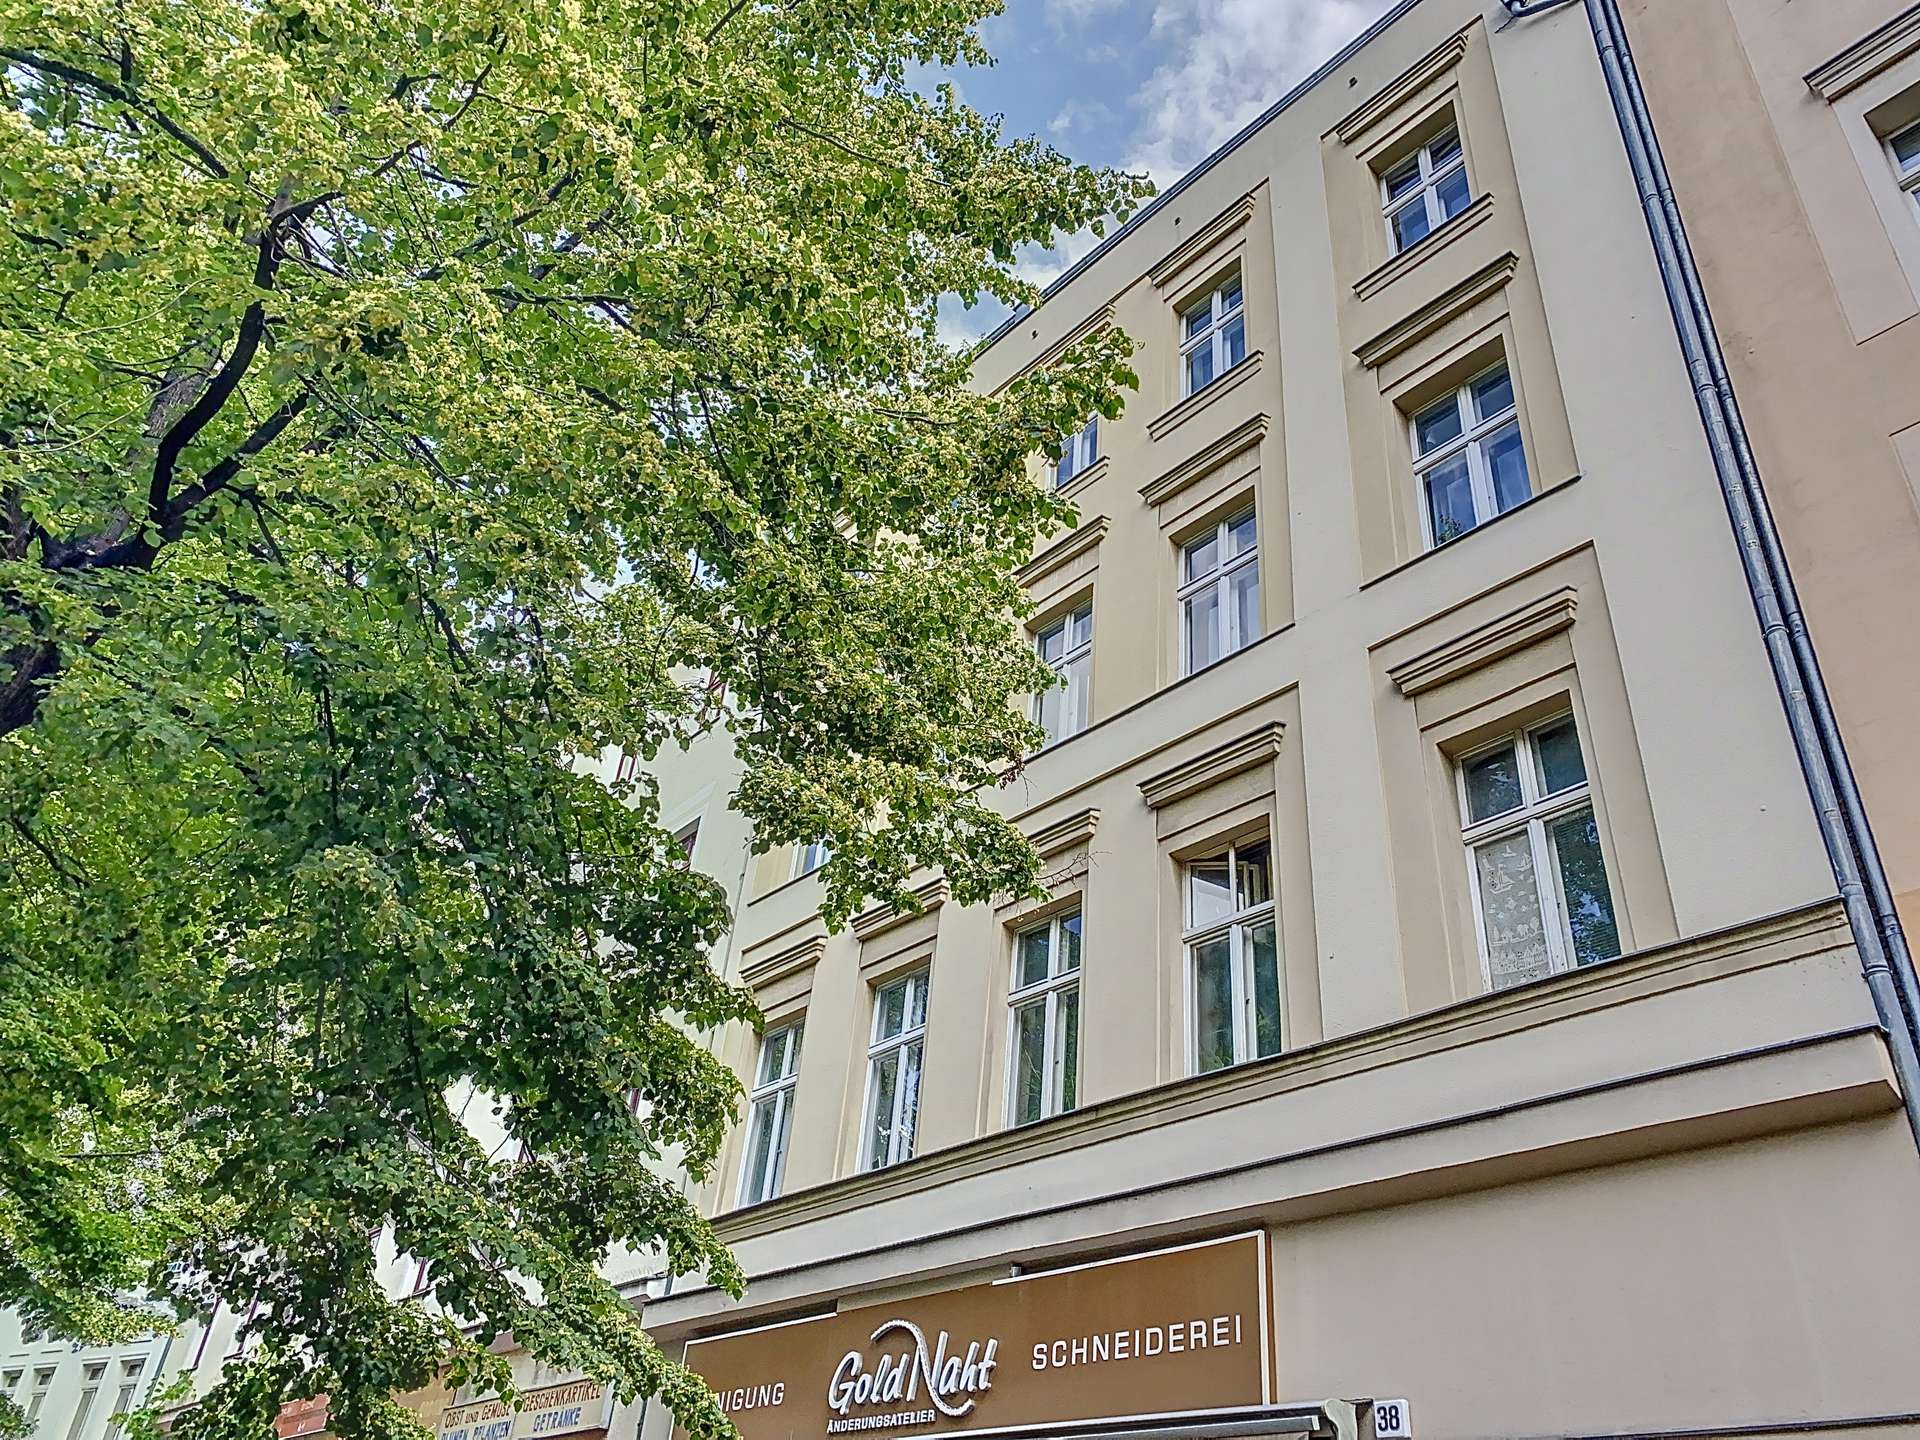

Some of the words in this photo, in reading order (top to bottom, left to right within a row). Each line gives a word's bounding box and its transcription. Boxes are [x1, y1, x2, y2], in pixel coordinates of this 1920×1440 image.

[1031, 1314, 1242, 1370] SCHNEIDEREI
[828, 1351, 911, 1415] Gold
[870, 1319, 999, 1416] Naht
[523, 1381, 601, 1412] GESCHENKARTIKEL
[715, 1382, 785, 1413] NIGUNG
[445, 1410, 465, 1428] OBST
[465, 1411, 480, 1424] UND
[1376, 1405, 1400, 1431] 38
